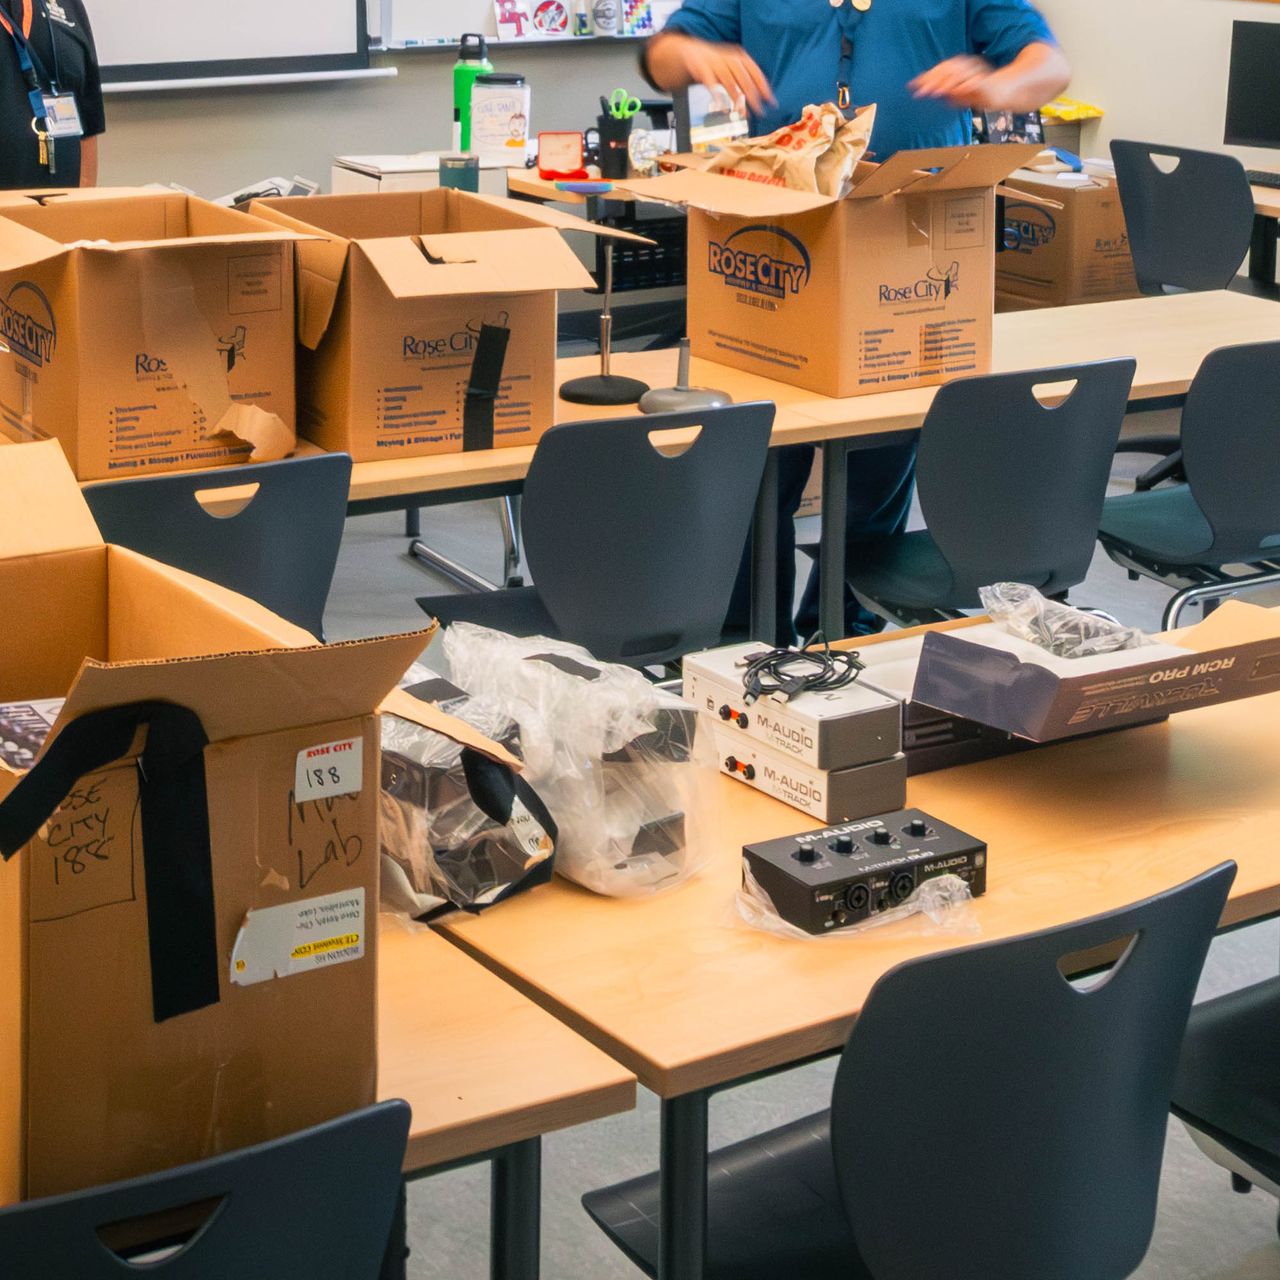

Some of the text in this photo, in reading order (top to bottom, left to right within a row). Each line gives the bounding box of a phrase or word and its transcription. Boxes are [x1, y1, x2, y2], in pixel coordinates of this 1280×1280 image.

[879, 279, 943, 302] Rose City
[403, 335, 447, 356] Rose
[1148, 656, 1236, 684] RCM PRO
[757, 714, 814, 750] M-AUDIO
[306, 742, 353, 758] ROSE CITY
[307, 766, 340, 788] 188
[764, 765, 822, 803] M-AUDIO
[47, 807, 110, 847] CITY
[795, 819, 885, 845] M-AUDIO
[297, 818, 363, 889] Lab
[923, 855, 968, 873] M-AUDIO
